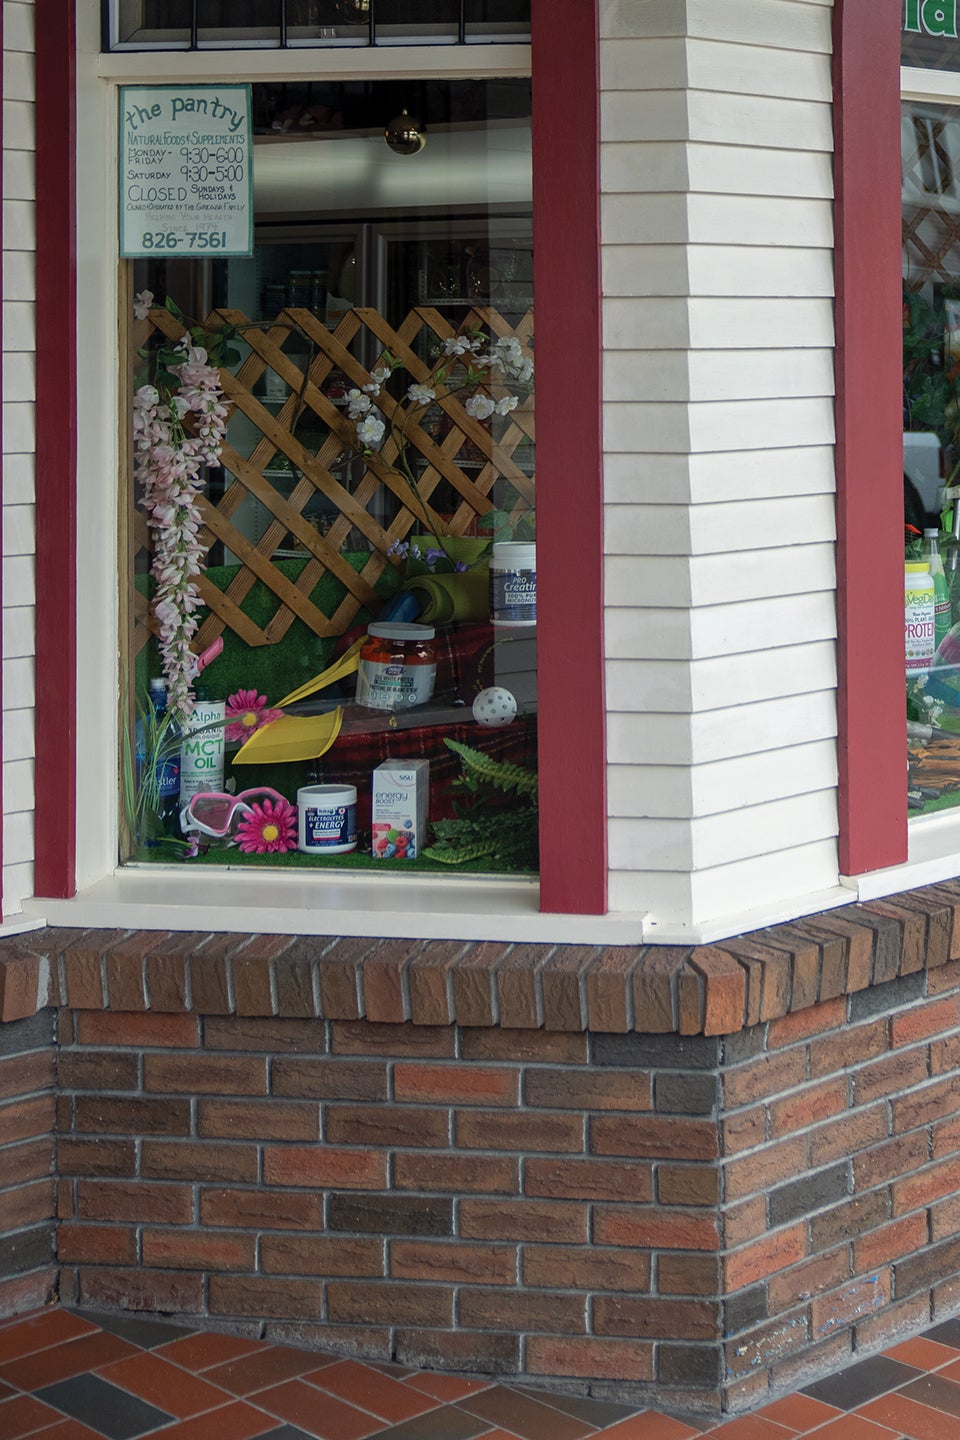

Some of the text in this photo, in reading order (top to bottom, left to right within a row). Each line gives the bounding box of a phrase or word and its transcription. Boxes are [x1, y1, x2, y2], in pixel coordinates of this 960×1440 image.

[126, 96, 246, 133] the pantry
[127, 131, 164, 146] NATURAL
[164, 131, 186, 146] FOODS
[192, 131, 245, 146] SUPPLEMENTS
[128, 156, 164, 165] FRIDAY
[127, 169, 172, 180] SATURDAY
[128, 184, 188, 202] CLOSED
[190, 184, 225, 194] SUNDAYS
[199, 192, 237, 201] HOLIDAYS
[142, 231, 227, 249] 826-7561
[190, 709, 221, 724] Alpha
[184, 738, 224, 757] MCT
[194, 757, 217, 769] OIL
[375, 791, 408, 802] energy
[315, 819, 346, 829] ENERGY
